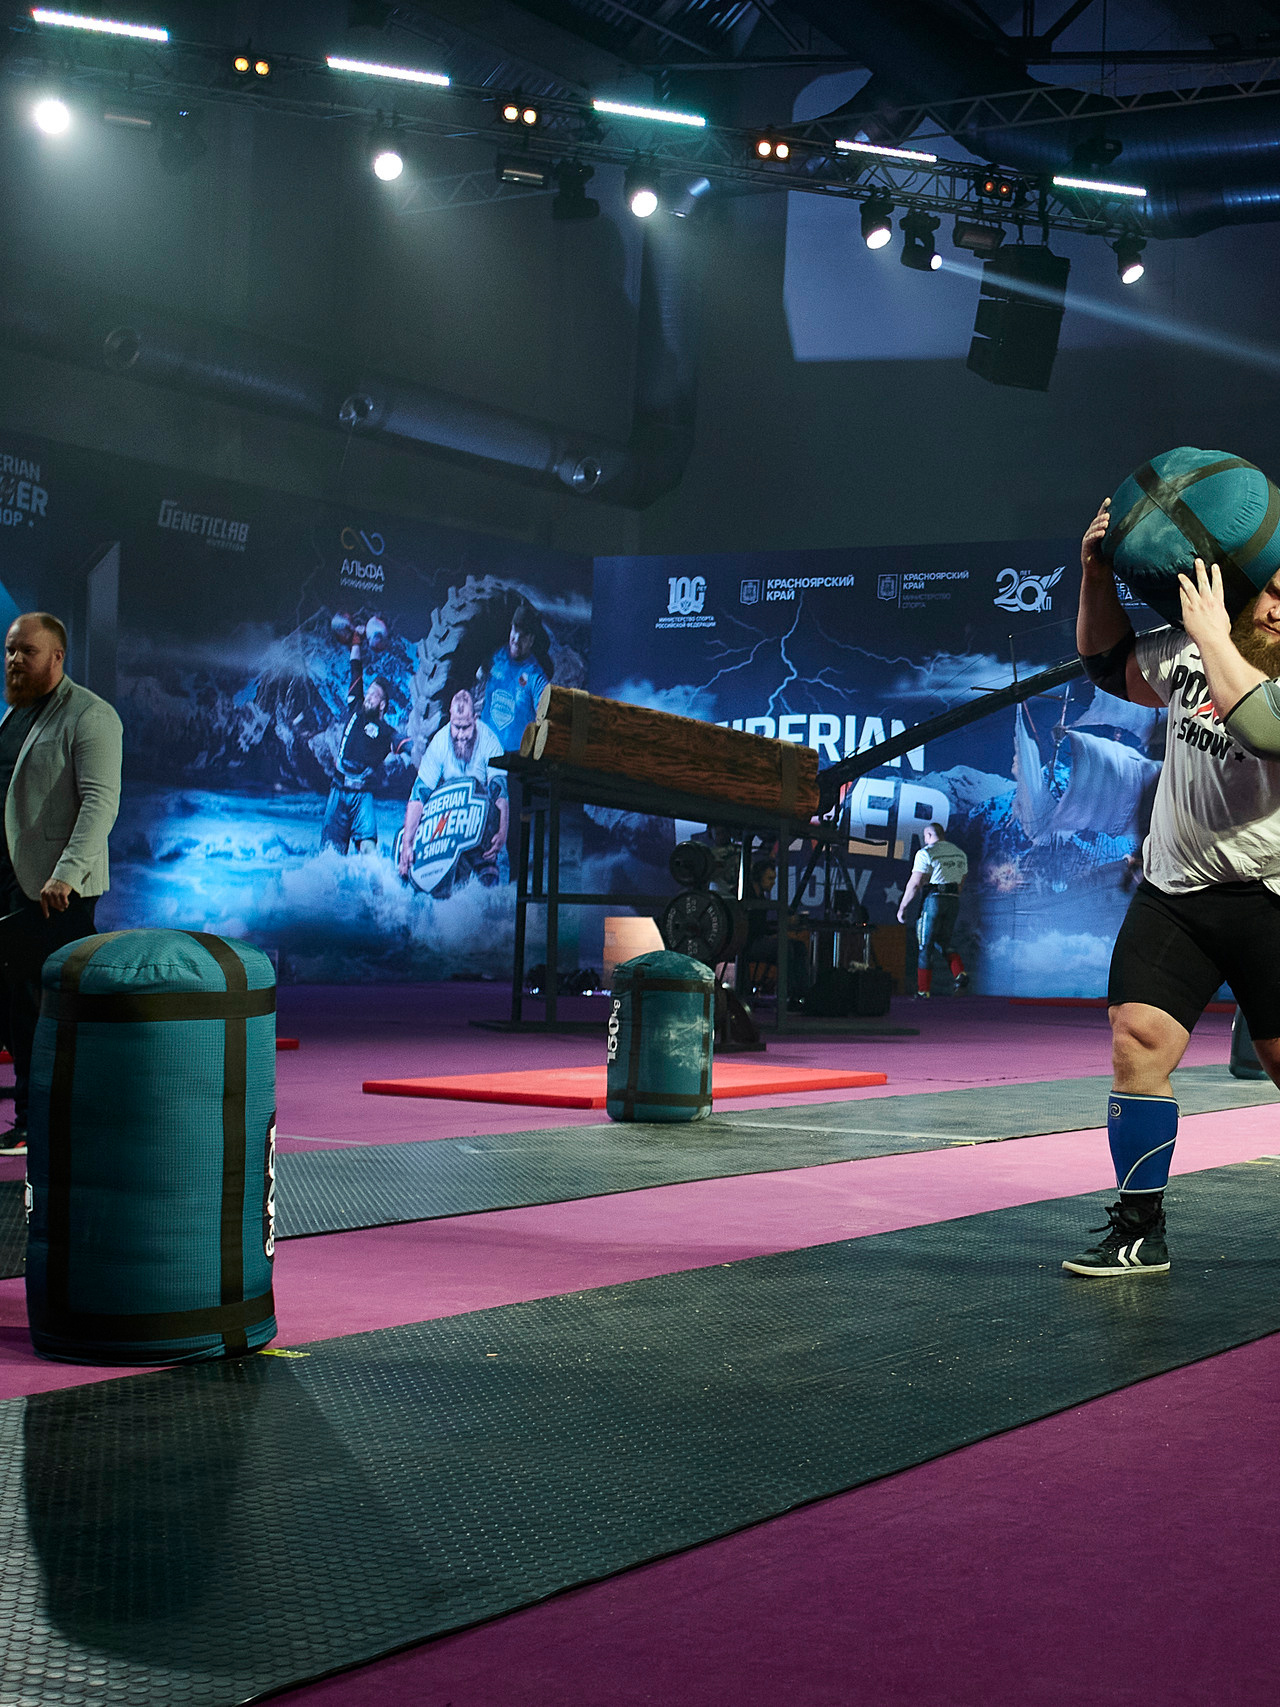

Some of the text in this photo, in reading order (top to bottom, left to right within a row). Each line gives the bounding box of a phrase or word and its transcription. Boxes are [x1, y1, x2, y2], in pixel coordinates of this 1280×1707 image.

[340, 558, 385, 581] АЛЬФА
[903, 570, 970, 581] КРАСНОЯРСКИЙ
[767, 574, 855, 590] КРАСНОЯРСКИЙ
[903, 580, 926, 590] КРАЙ
[766, 588, 796, 601] КРАЙ
[1177, 718, 1234, 760] SHOW
[423, 790, 468, 819] SIBERIAN
[413, 806, 469, 846] POWER
[423, 838, 452, 861] SHOW
